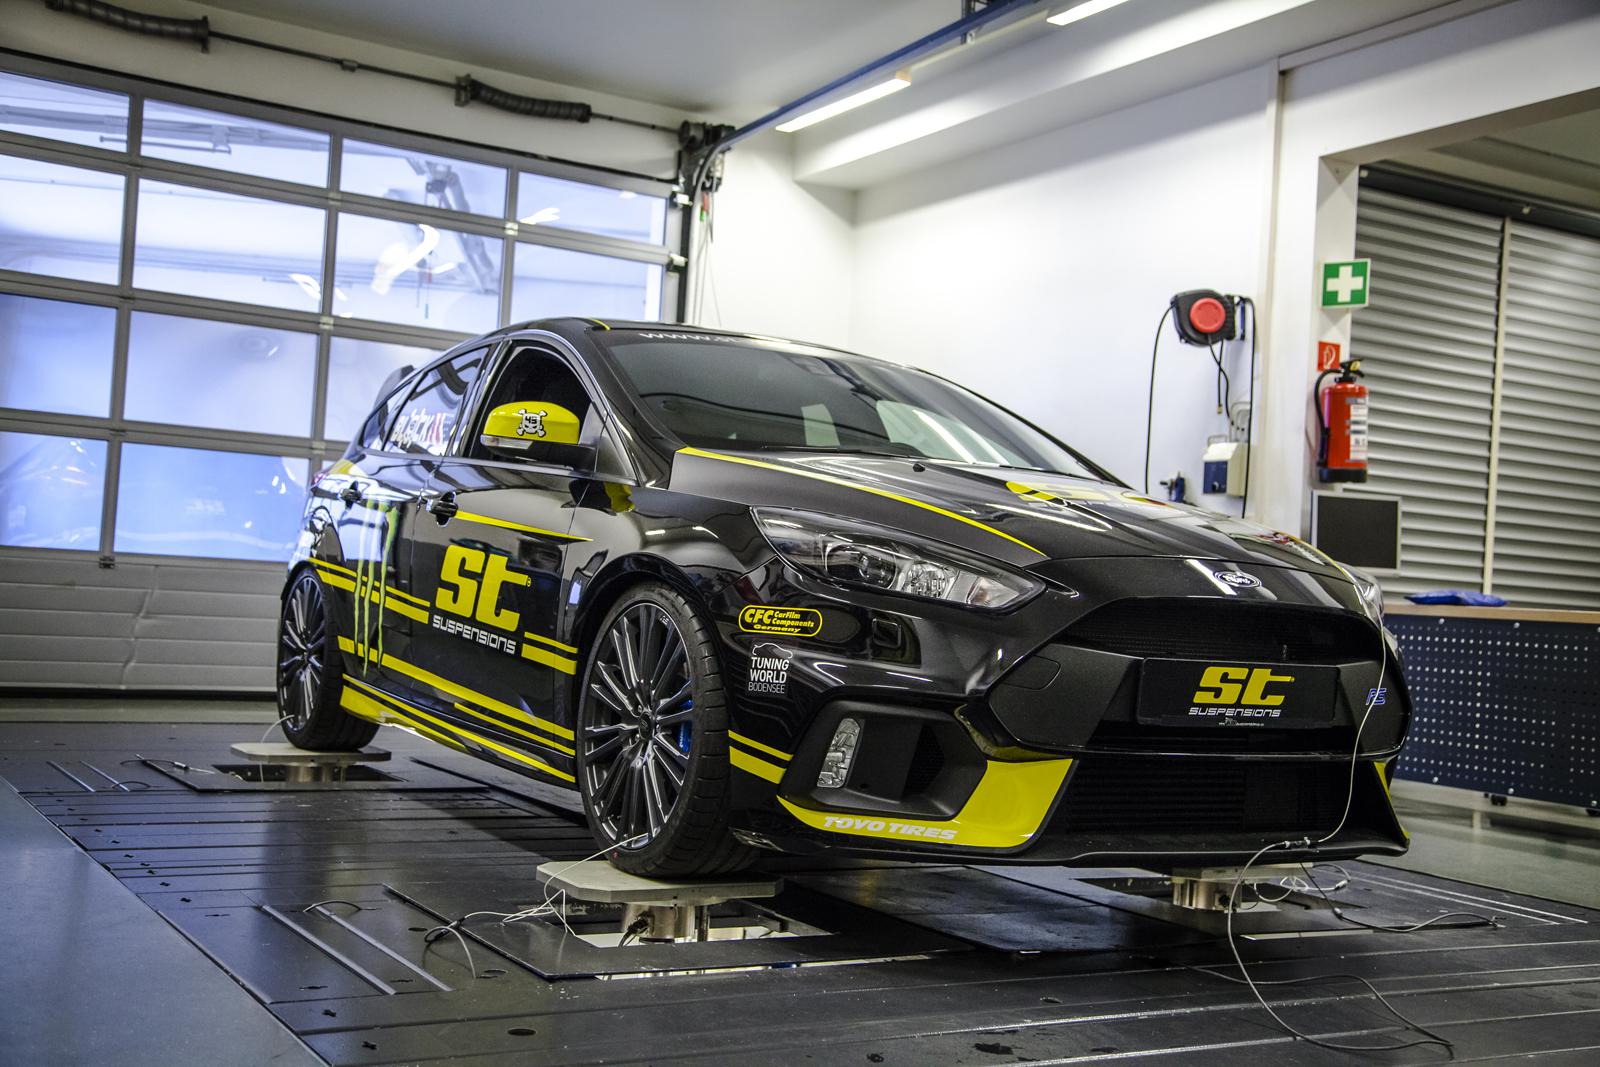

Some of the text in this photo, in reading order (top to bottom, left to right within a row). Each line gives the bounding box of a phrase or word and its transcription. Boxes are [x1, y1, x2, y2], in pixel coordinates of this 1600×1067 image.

[744, 608, 774, 625] CFC
[774, 611, 801, 620] CarFilm
[753, 624, 801, 634] Germany
[772, 618, 814, 628] Components
[751, 656, 790, 671] TUNING
[749, 669, 787, 684] WORLD
[748, 681, 786, 695] BODENSEE
[823, 816, 959, 841] TOYO TIRES
